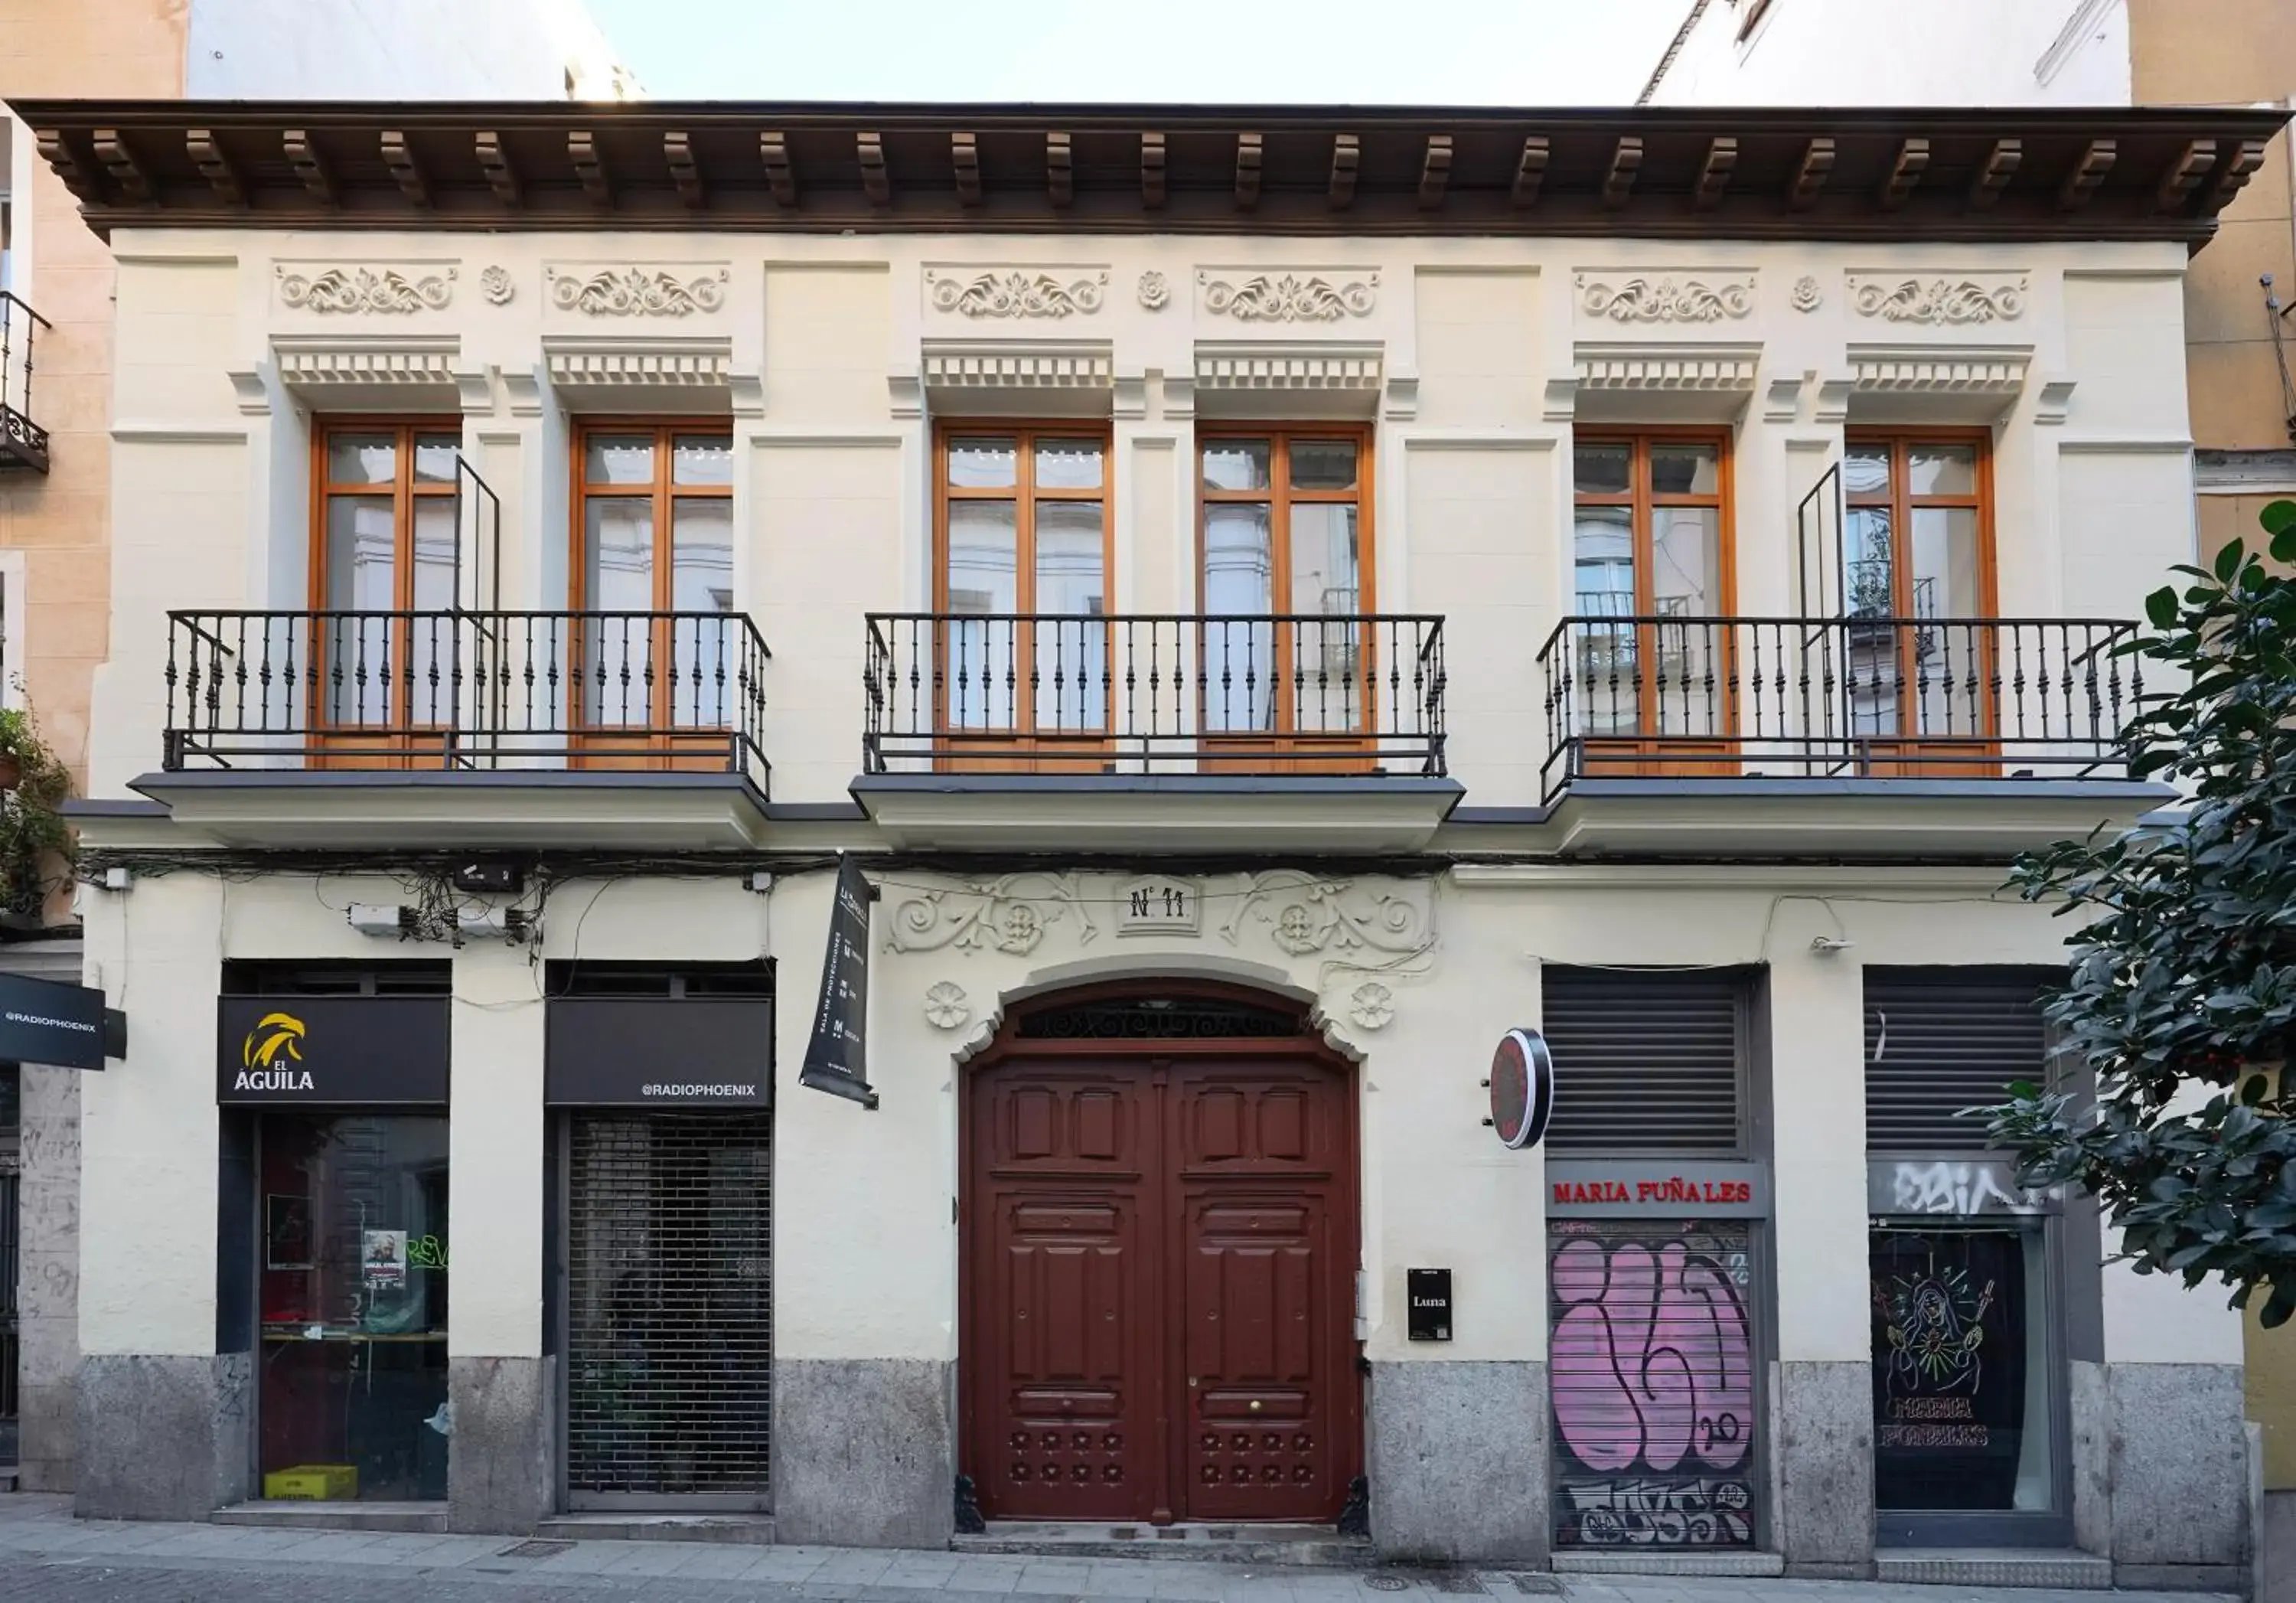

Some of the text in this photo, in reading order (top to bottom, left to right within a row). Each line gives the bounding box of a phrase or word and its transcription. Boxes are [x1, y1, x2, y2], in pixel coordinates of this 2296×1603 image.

[1163, 887, 1184, 917] 11
[5, 1011, 96, 1033] @RADIOPHOENIX
[275, 1060, 287, 1071] EL
[641, 1083, 755, 1095] @RADIOPHOENIX
[1554, 1176, 1751, 1203] MARIA PUÑALES
[1414, 1295, 1446, 1307] Luna
